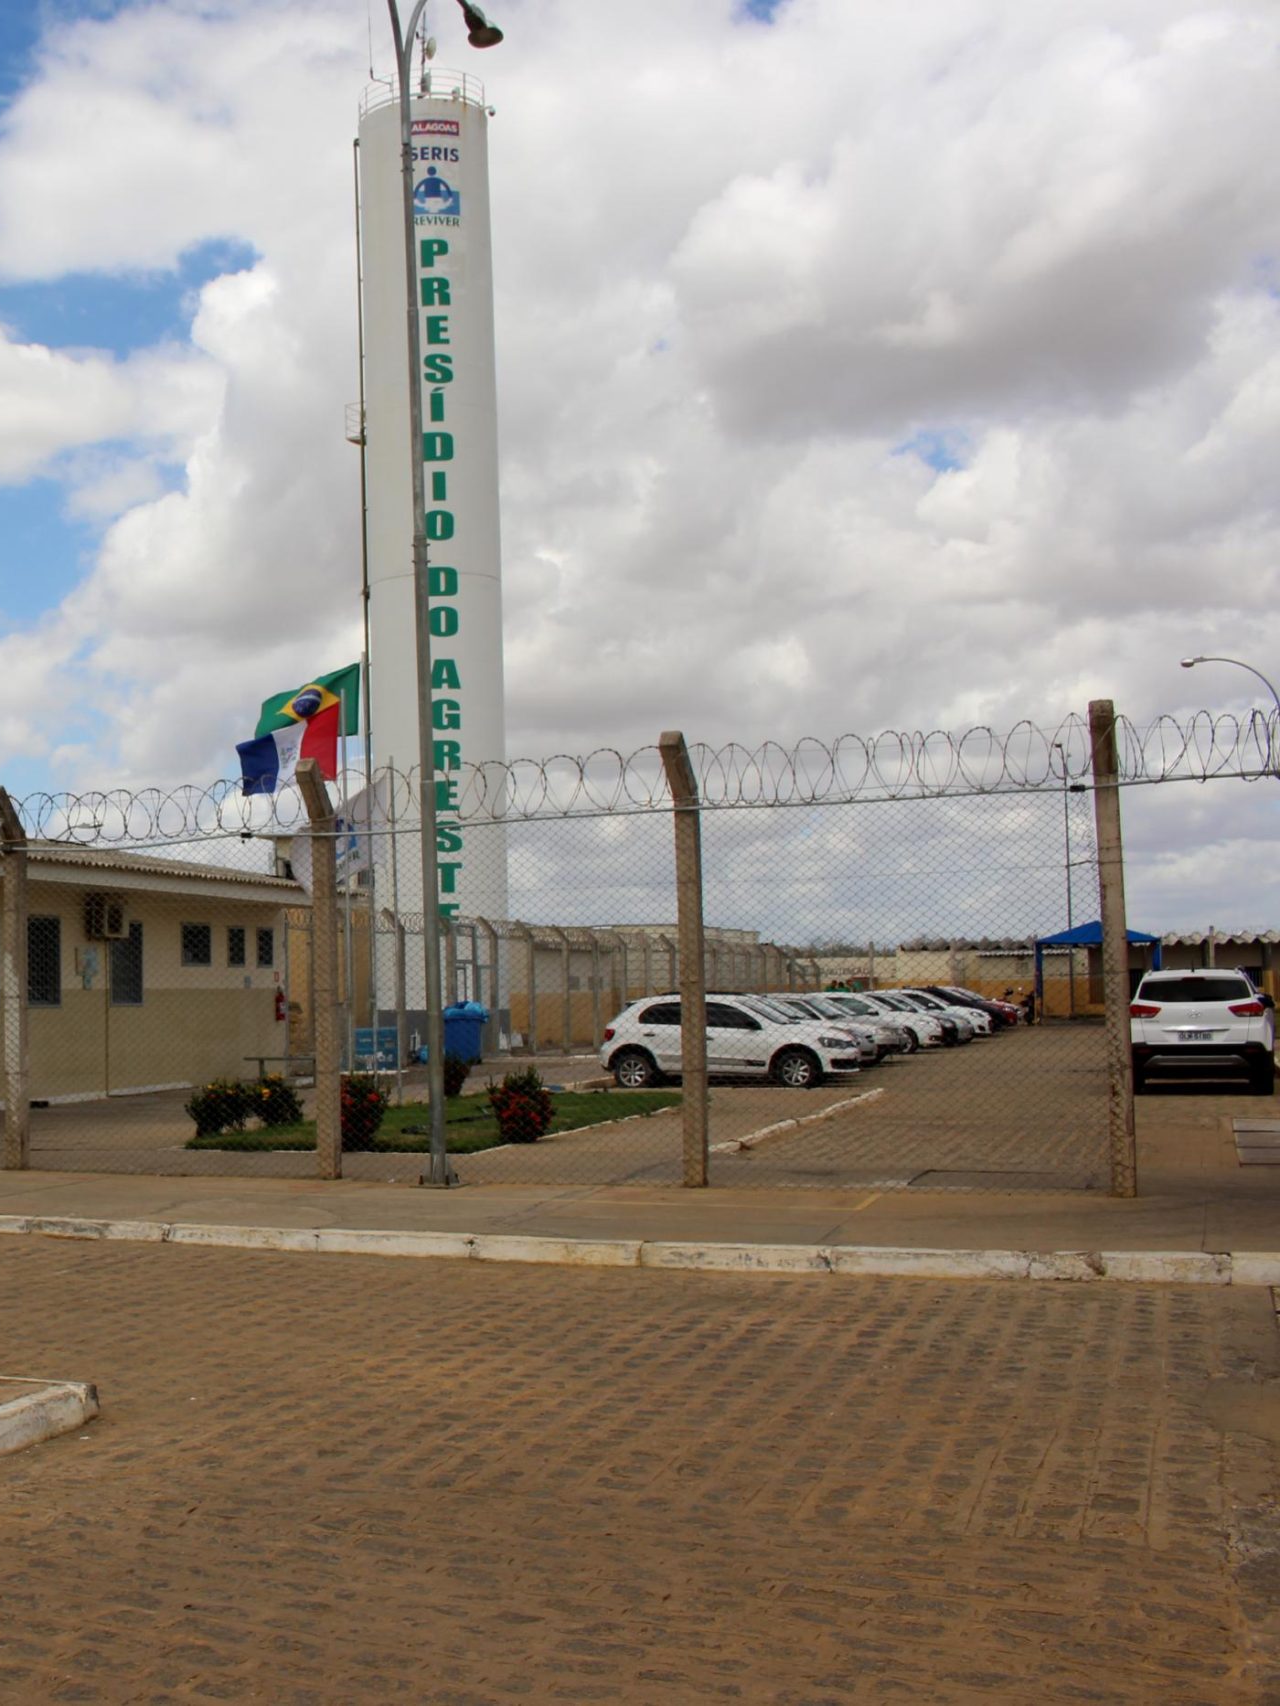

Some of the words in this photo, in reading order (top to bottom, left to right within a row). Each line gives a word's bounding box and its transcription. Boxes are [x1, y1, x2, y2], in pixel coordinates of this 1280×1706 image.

[411, 122, 458, 132] ALAGOAS
[411, 147, 459, 162] SERIS
[413, 215, 460, 228] REVIVER
[420, 239, 455, 541] PRESÍDIO
[428, 566, 460, 637] DO
